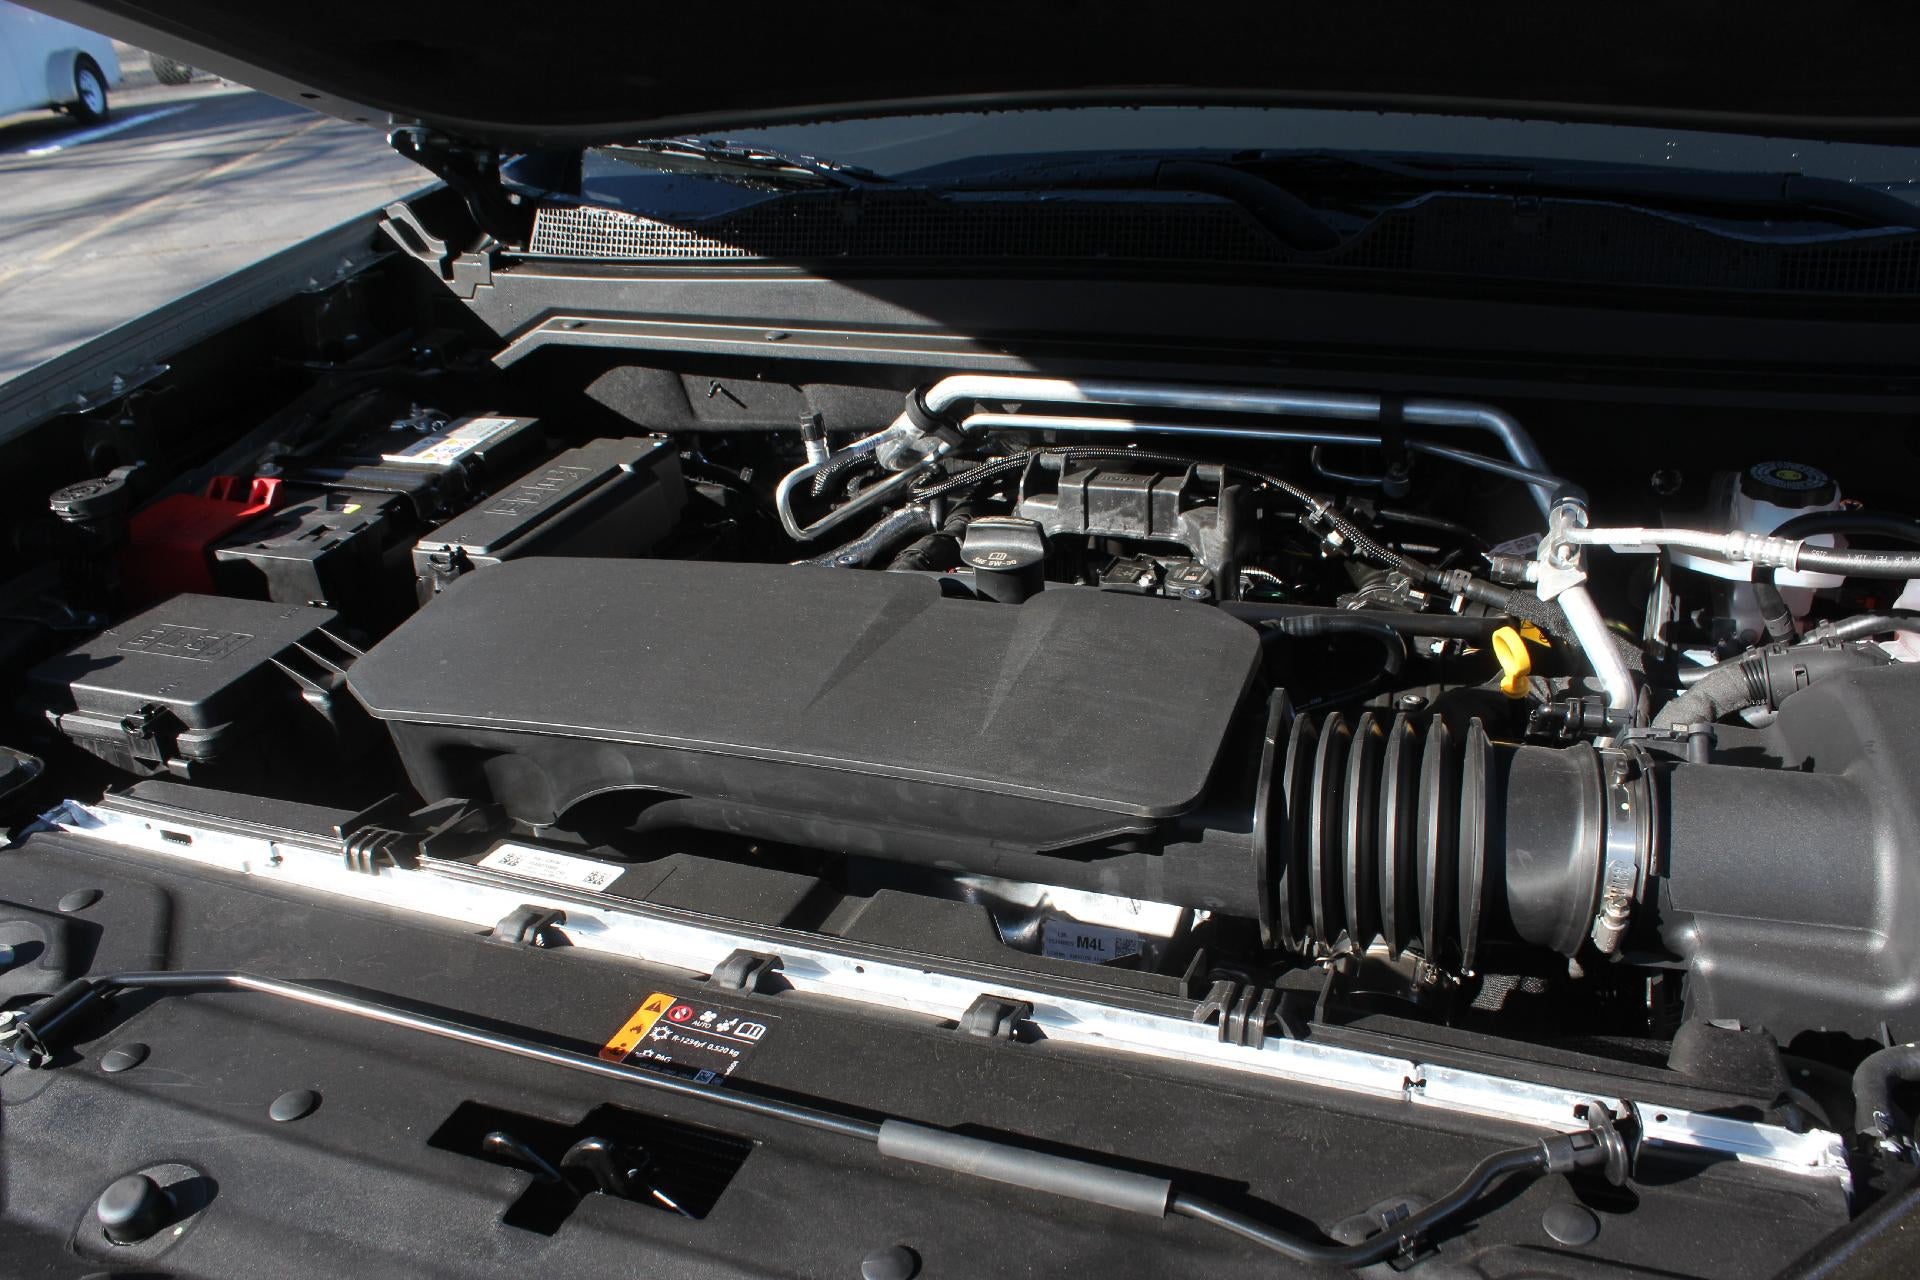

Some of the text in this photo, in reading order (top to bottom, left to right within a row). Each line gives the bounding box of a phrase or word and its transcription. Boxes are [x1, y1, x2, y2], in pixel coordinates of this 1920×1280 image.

[1077, 936, 1105, 951] M4L
[671, 1035, 707, 1047] R-1234yf
[729, 1048, 740, 1057] kg
[655, 1054, 673, 1063] PAG
